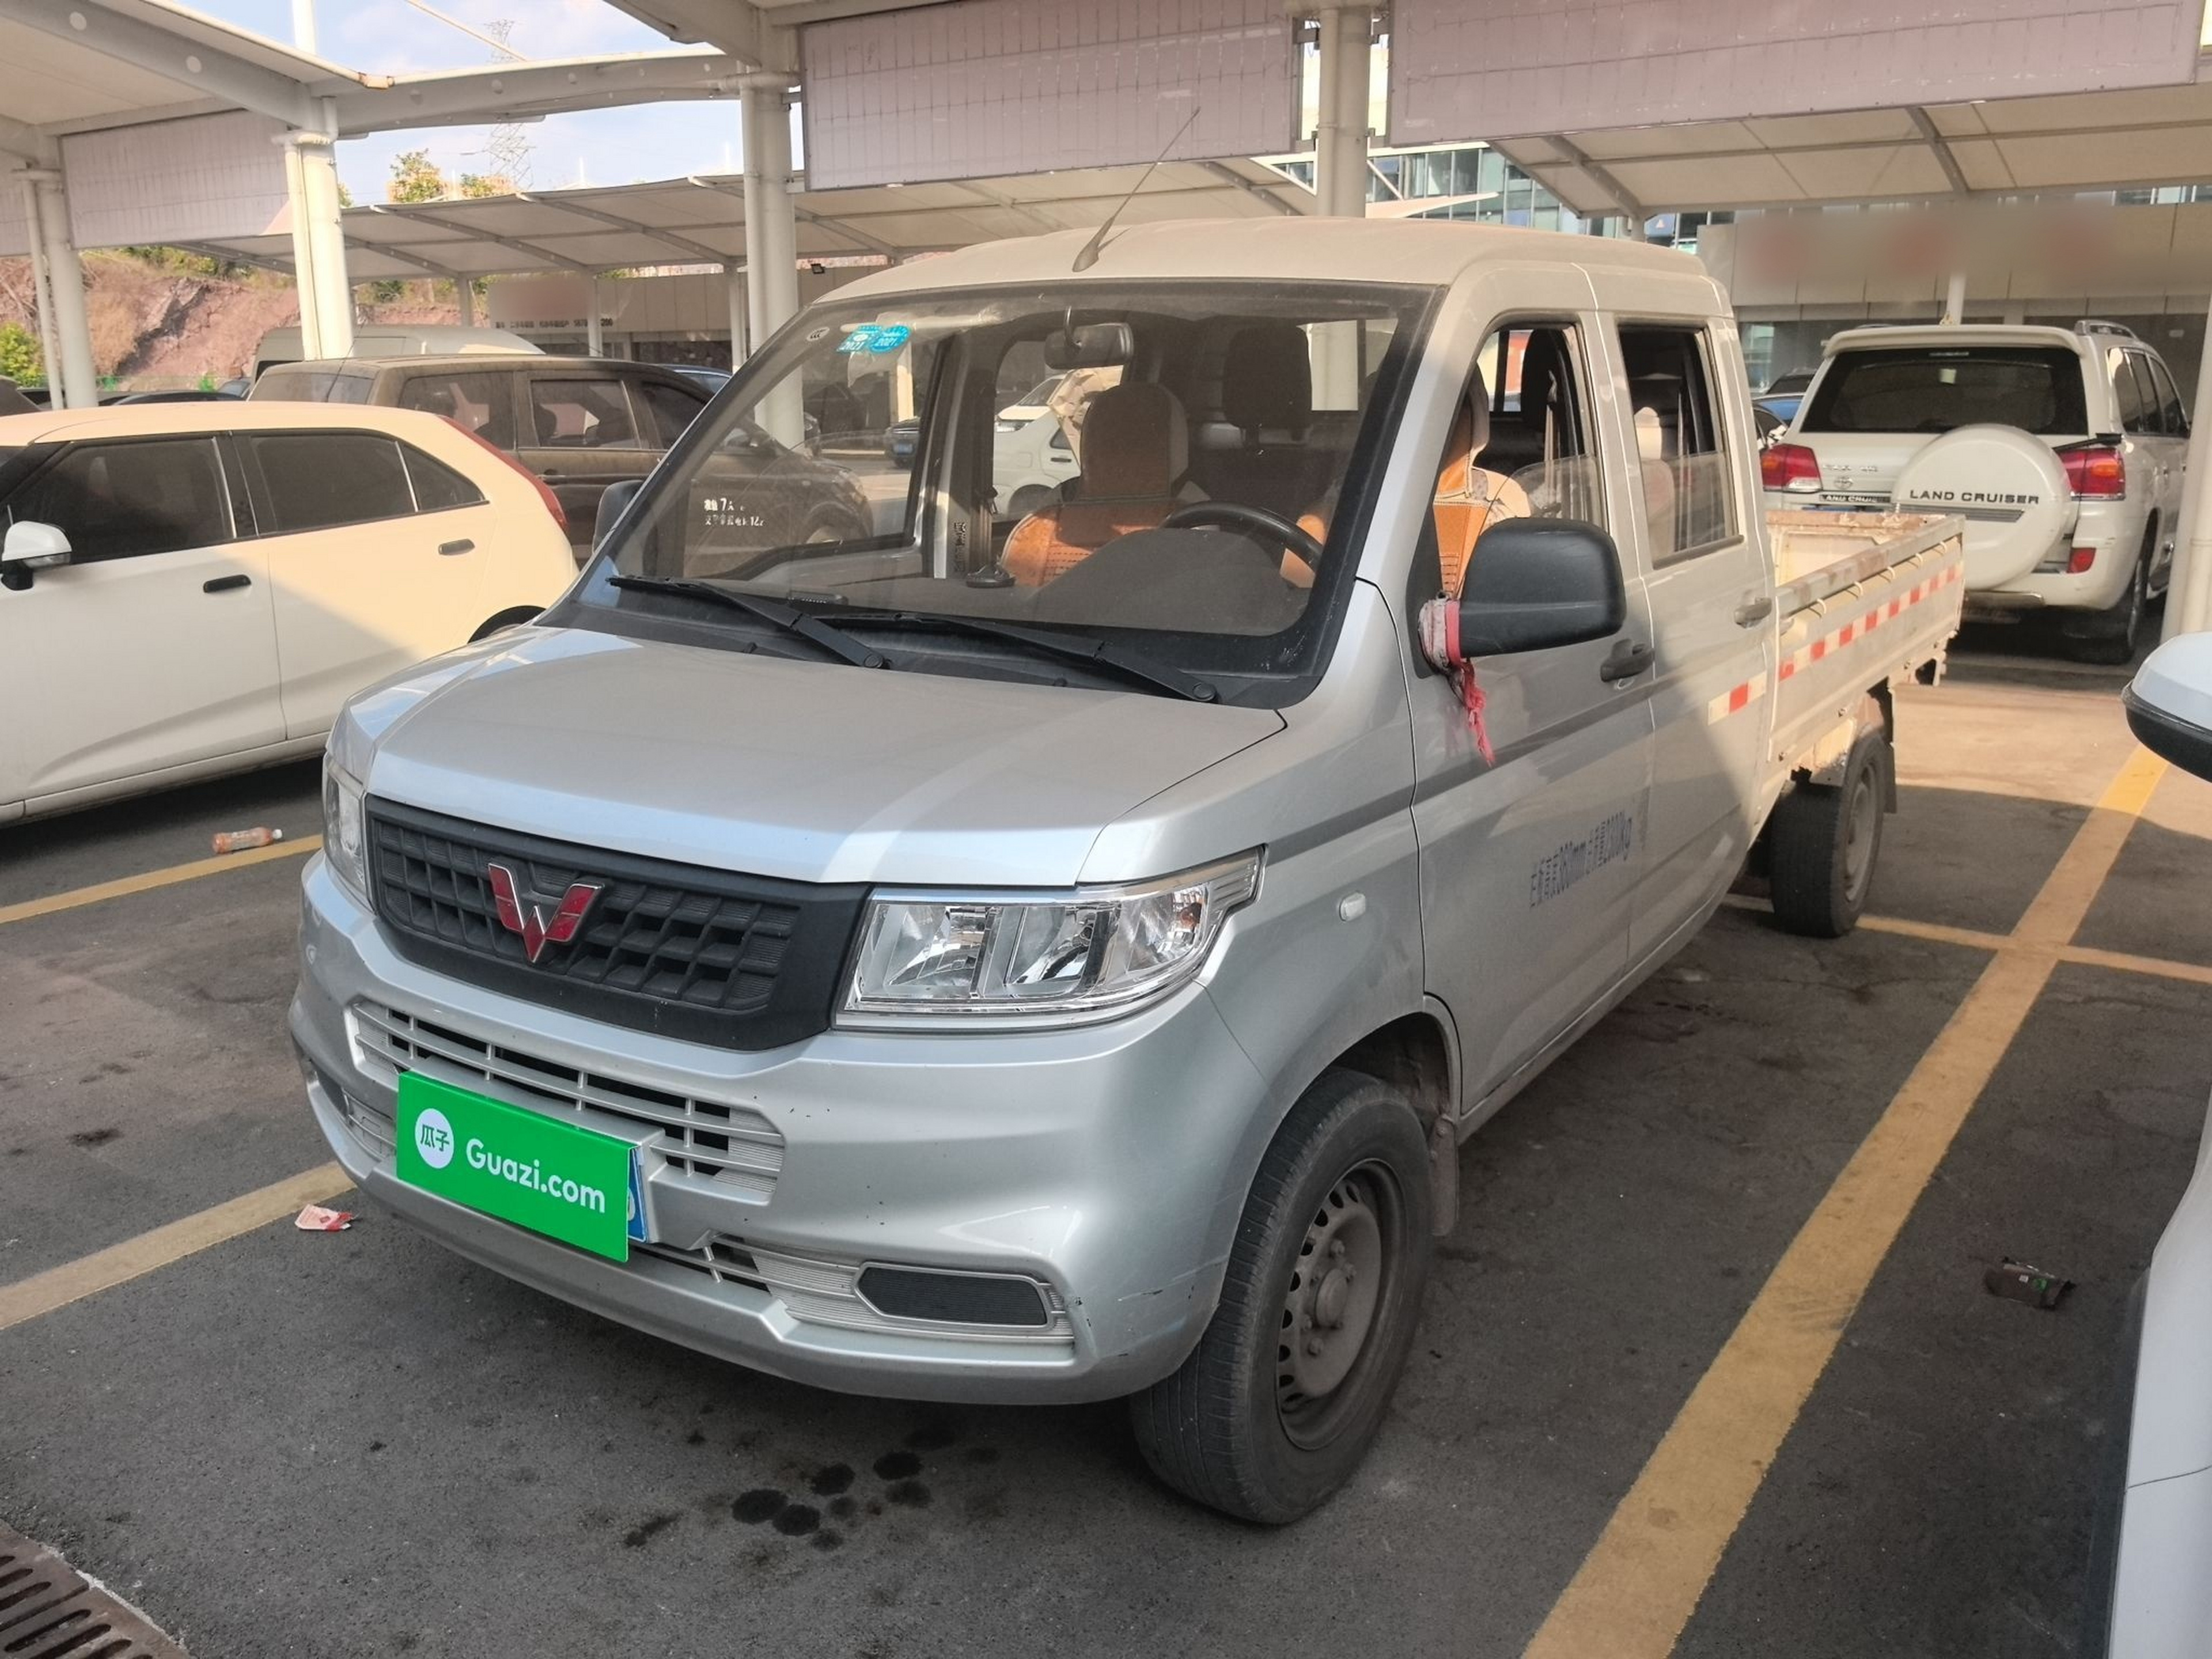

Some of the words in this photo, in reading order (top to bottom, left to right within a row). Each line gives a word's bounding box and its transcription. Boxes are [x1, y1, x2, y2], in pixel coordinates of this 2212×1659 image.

[1910, 489, 1955, 501] LAND
[1961, 492, 2040, 505] CRUISER
[419, 1124, 450, 1152] 瓜子
[465, 1138, 606, 1214] Guazi.com
